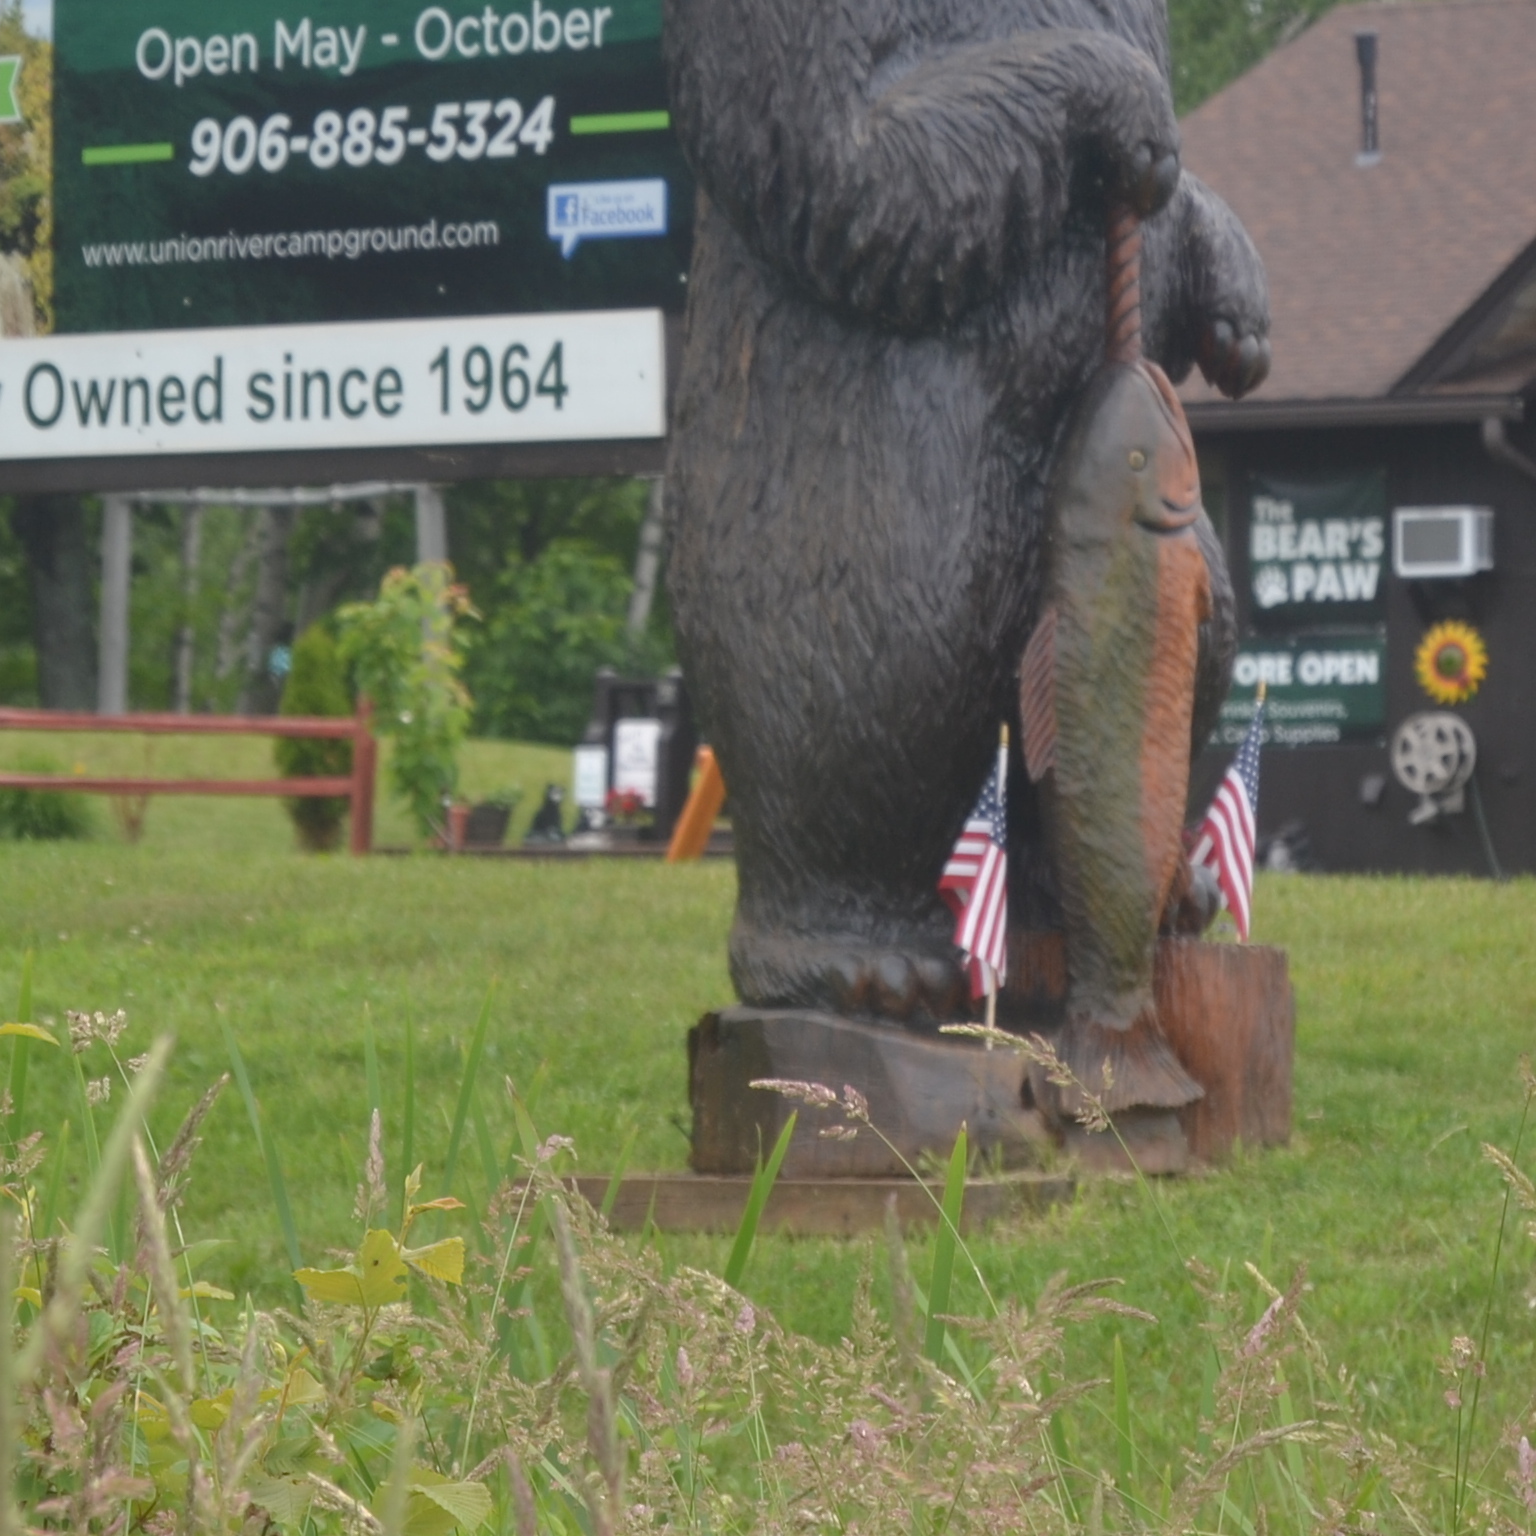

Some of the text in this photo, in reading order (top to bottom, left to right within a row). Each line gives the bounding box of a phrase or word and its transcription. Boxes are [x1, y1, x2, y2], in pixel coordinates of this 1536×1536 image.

[135, 26, 260, 86] Open
[273, 16, 368, 74] May
[188, 94, 556, 176] 906-885-5324
[582, 204, 655, 226] Facebook
[81, 219, 499, 268] www.unionrivercampground.com
[22, 358, 226, 430] Owned
[245, 350, 404, 423] since
[426, 339, 570, 416] 1964
[1252, 518, 1384, 560] BEAR'S
[1292, 563, 1380, 602] PAW
[1298, 650, 1379, 686] OPEN
